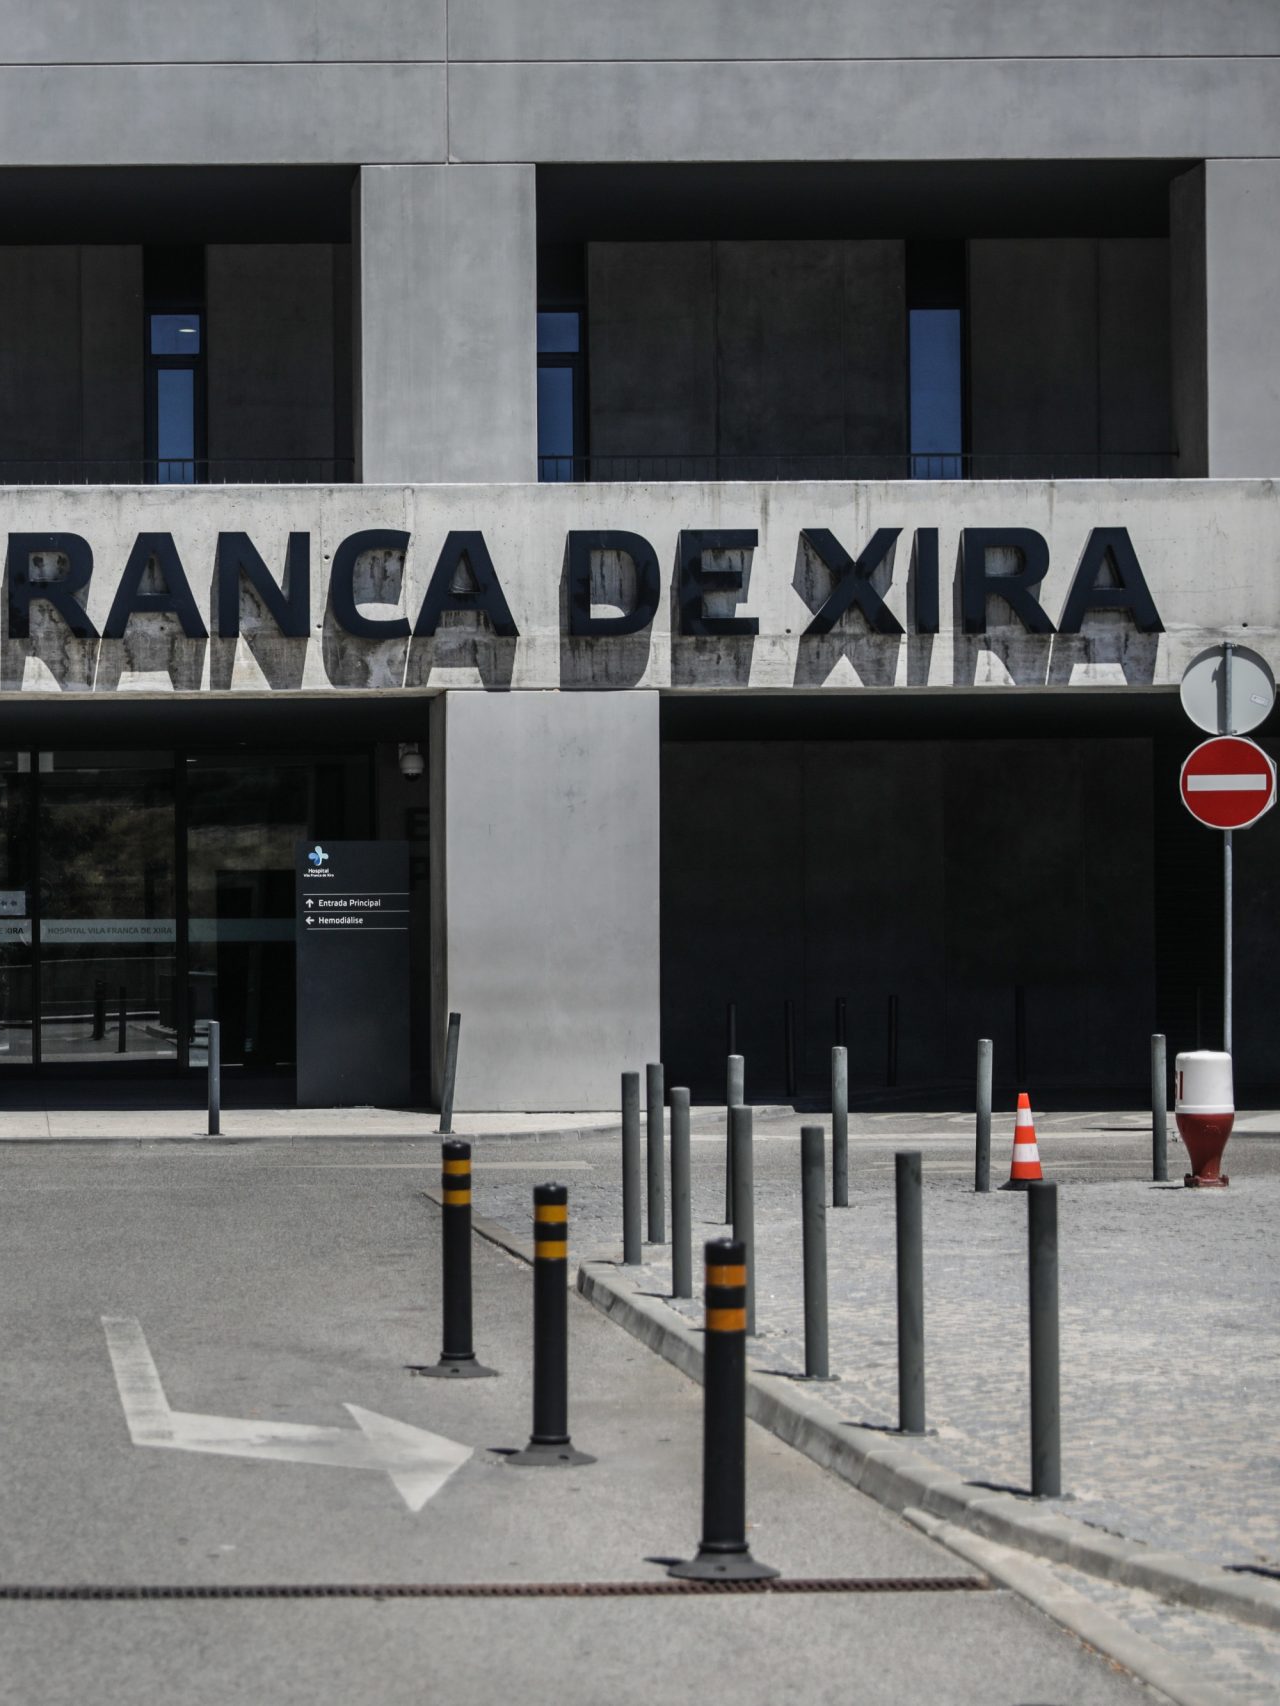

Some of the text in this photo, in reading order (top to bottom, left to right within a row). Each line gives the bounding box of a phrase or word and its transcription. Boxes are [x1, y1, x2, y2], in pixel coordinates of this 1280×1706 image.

[568, 528, 760, 637] DE
[800, 526, 1166, 634] XIRA
[318, 899, 381, 908] Entrada Principal
[318, 916, 364, 924] Hemodiálise
